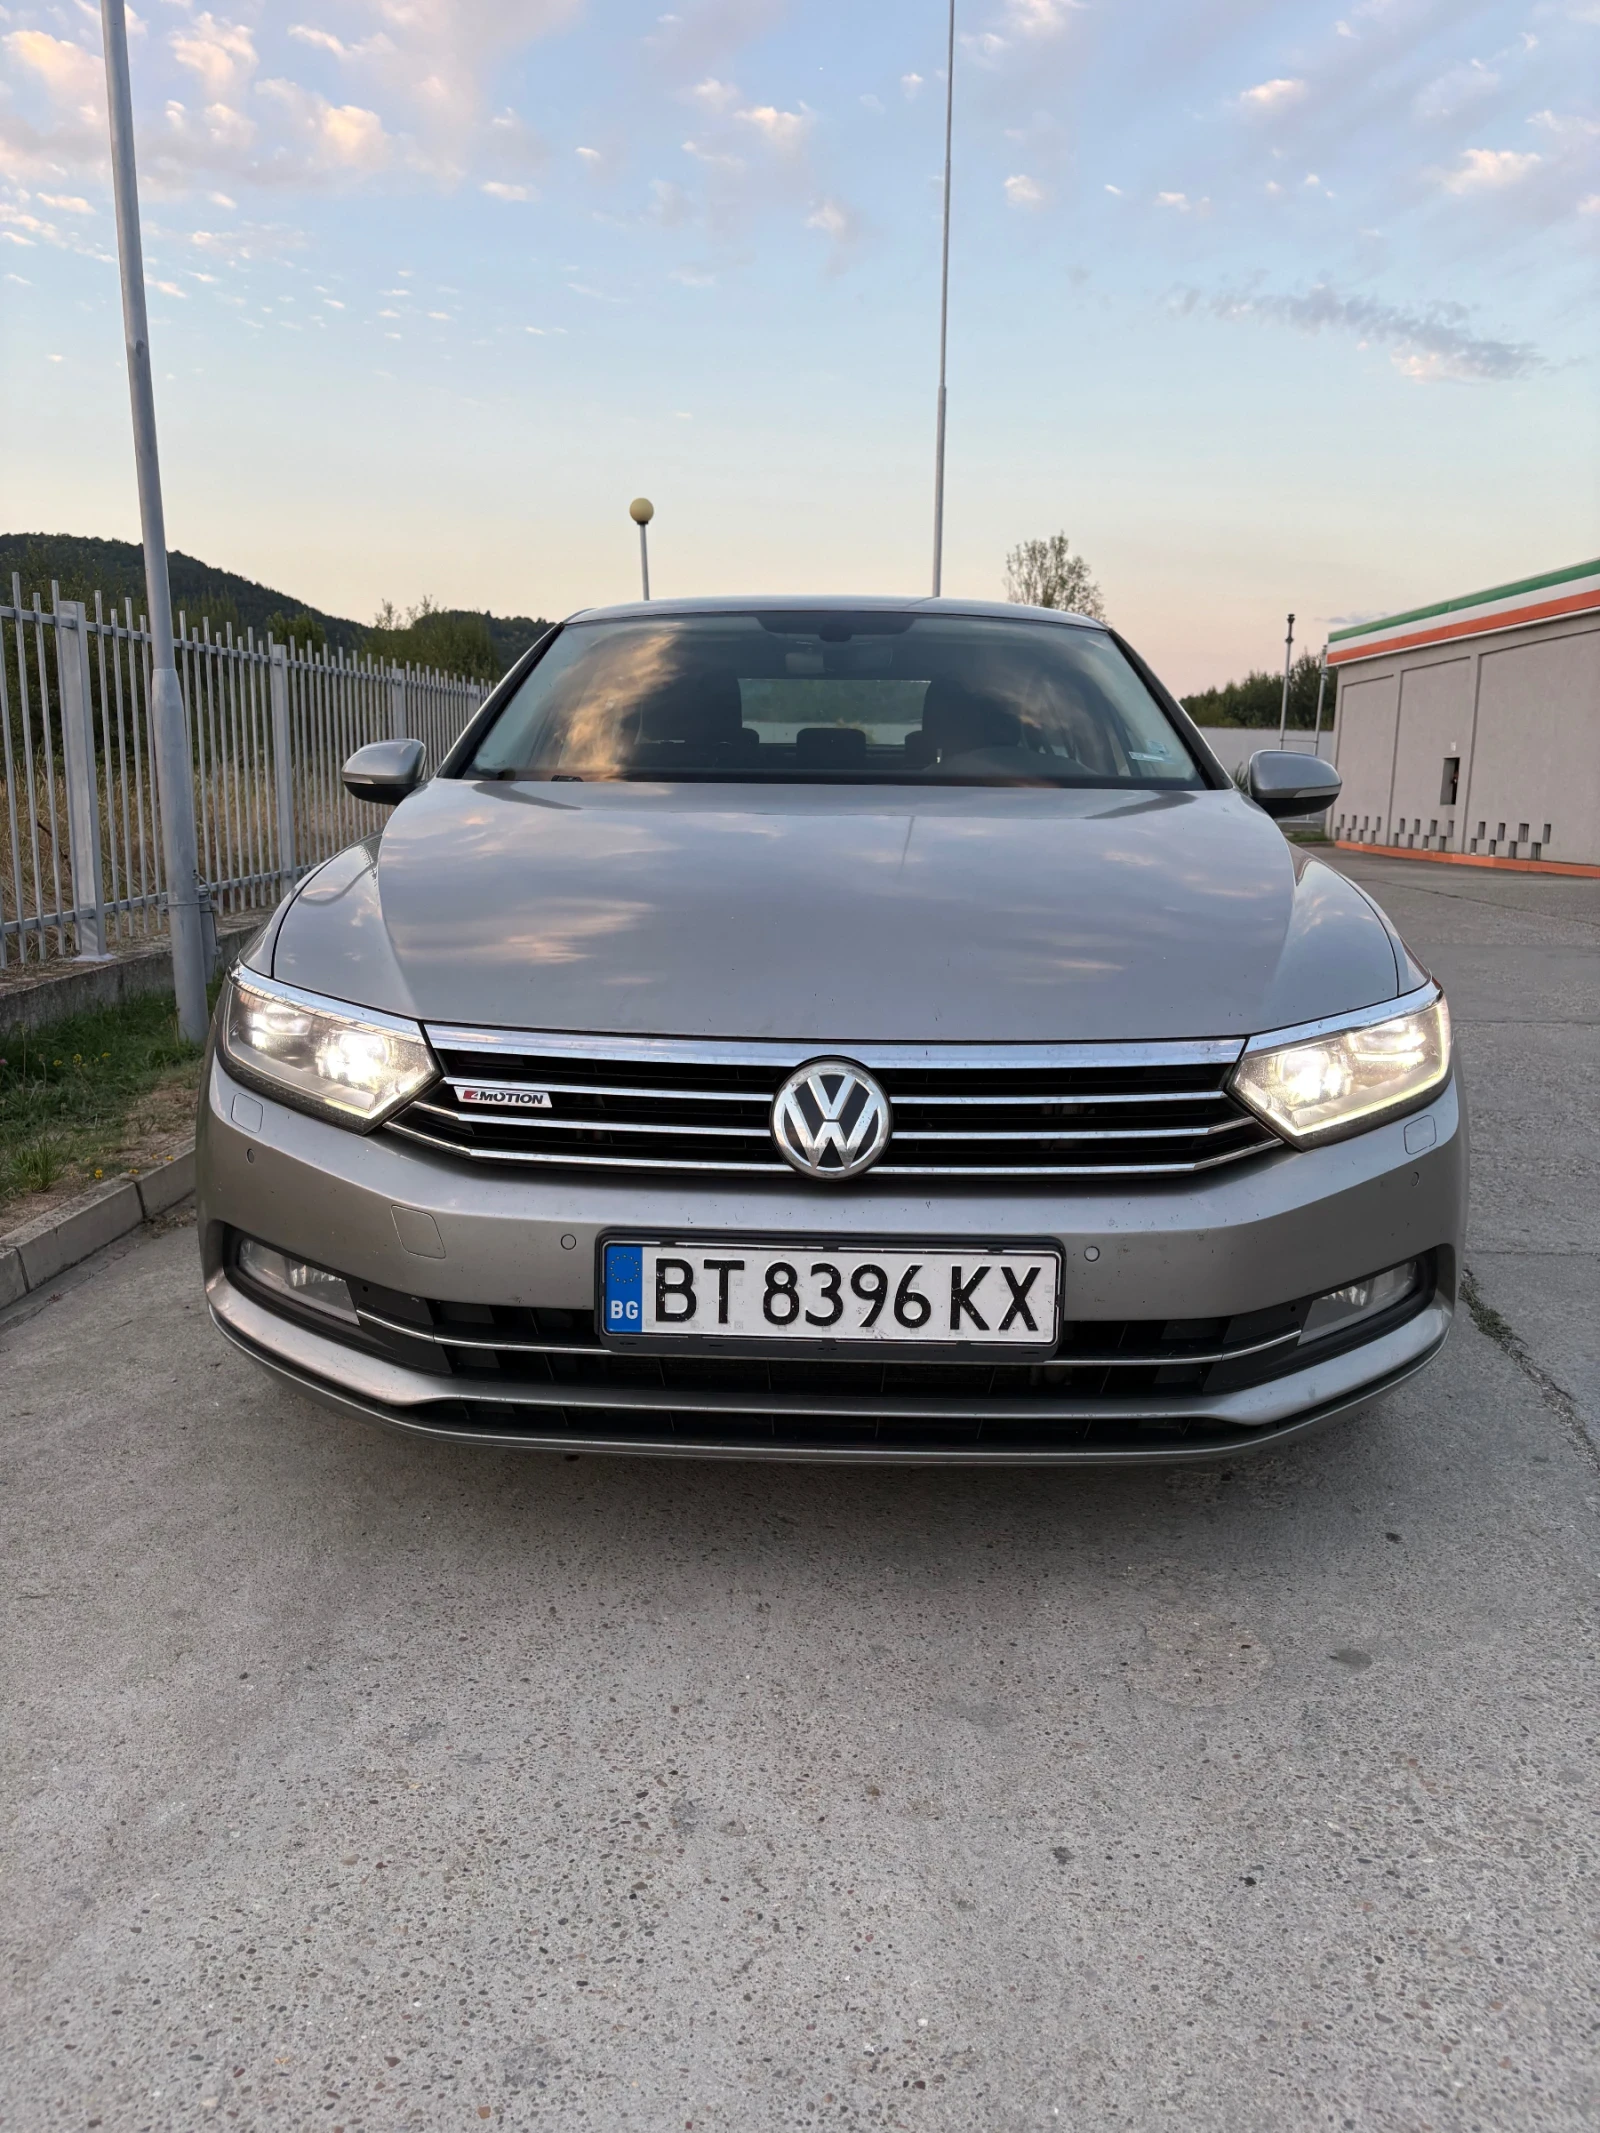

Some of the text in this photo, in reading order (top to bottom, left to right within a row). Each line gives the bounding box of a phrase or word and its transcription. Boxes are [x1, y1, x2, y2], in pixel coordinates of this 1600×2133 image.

[610, 1300, 639, 1319] BG
[655, 1258, 1039, 1331] BT 8396 KX
